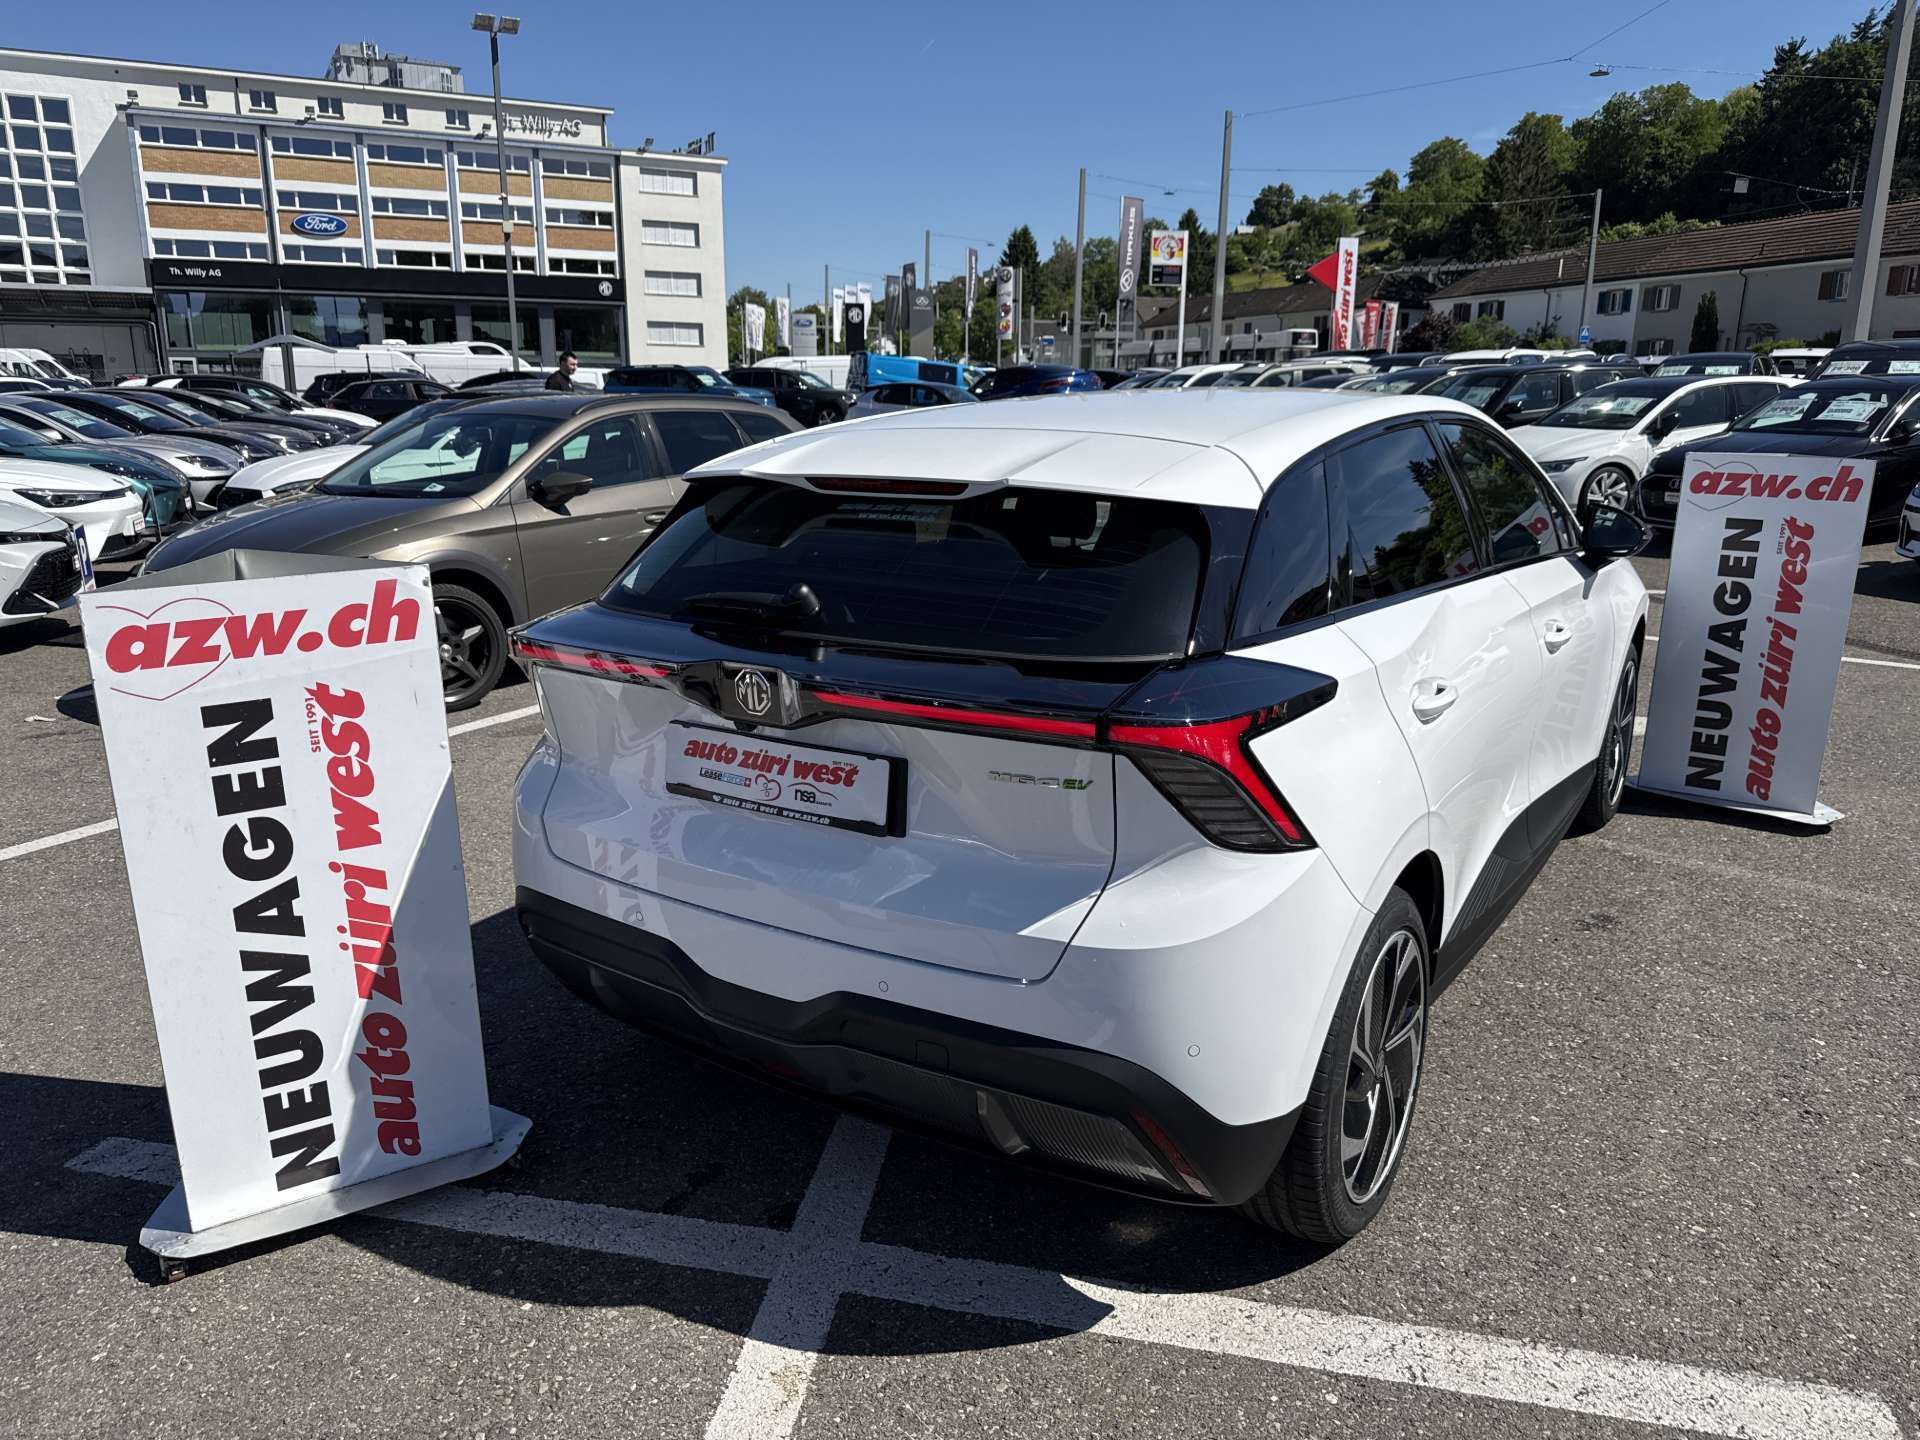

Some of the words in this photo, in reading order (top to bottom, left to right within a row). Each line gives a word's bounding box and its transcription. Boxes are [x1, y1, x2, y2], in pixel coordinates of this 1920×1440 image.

[304, 215, 337, 231] Ford
[168, 266, 183, 276] Th.
[184, 267, 207, 278] Willy
[208, 268, 222, 277] AG
[1689, 466, 1864, 502] azw.ch
[1774, 515, 1816, 614] west
[105, 579, 420, 674] azw.ch
[1685, 517, 1764, 791] NEUWAGEN
[1757, 615, 1799, 710] züri
[306, 696, 319, 726] 1991
[737, 672, 769, 712] MG
[304, 681, 384, 852] west
[309, 728, 321, 753] SEIT
[683, 738, 738, 765] auto
[738, 748, 792, 776] züri
[793, 759, 859, 788] west
[1746, 706, 1782, 801] auto
[722, 797, 741, 807] auto
[759, 804, 779, 815] west
[199, 697, 341, 1192] NEUWAGEN
[328, 859, 403, 1006] züri
[356, 1011, 422, 1157] auto
